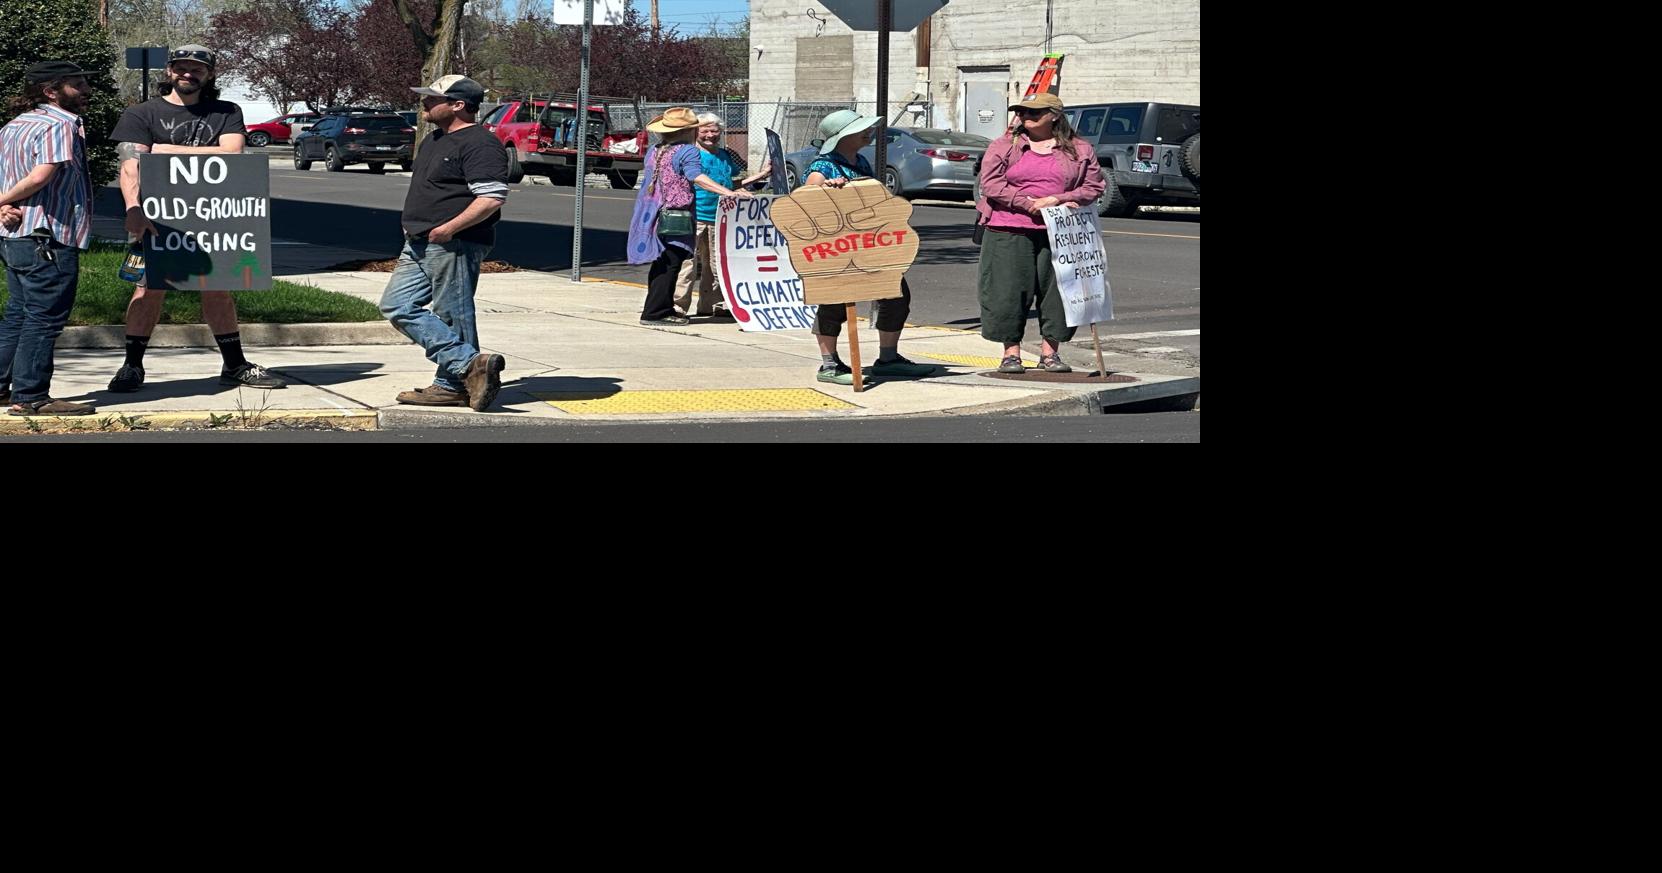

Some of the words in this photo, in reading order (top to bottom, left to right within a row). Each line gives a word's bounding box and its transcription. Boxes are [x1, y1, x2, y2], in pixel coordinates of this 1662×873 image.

[170, 156, 228, 185] NO
[143, 196, 266, 221] OLD-GROWTH
[735, 197, 778, 222] FOR
[1055, 212, 1093, 230] PROTECT
[151, 231, 256, 254] LOGGING
[735, 225, 788, 249] DEFEN
[802, 230, 907, 263] PROTECT
[1055, 231, 1095, 249] RESILIENT
[736, 279, 803, 305] CLIMATE
